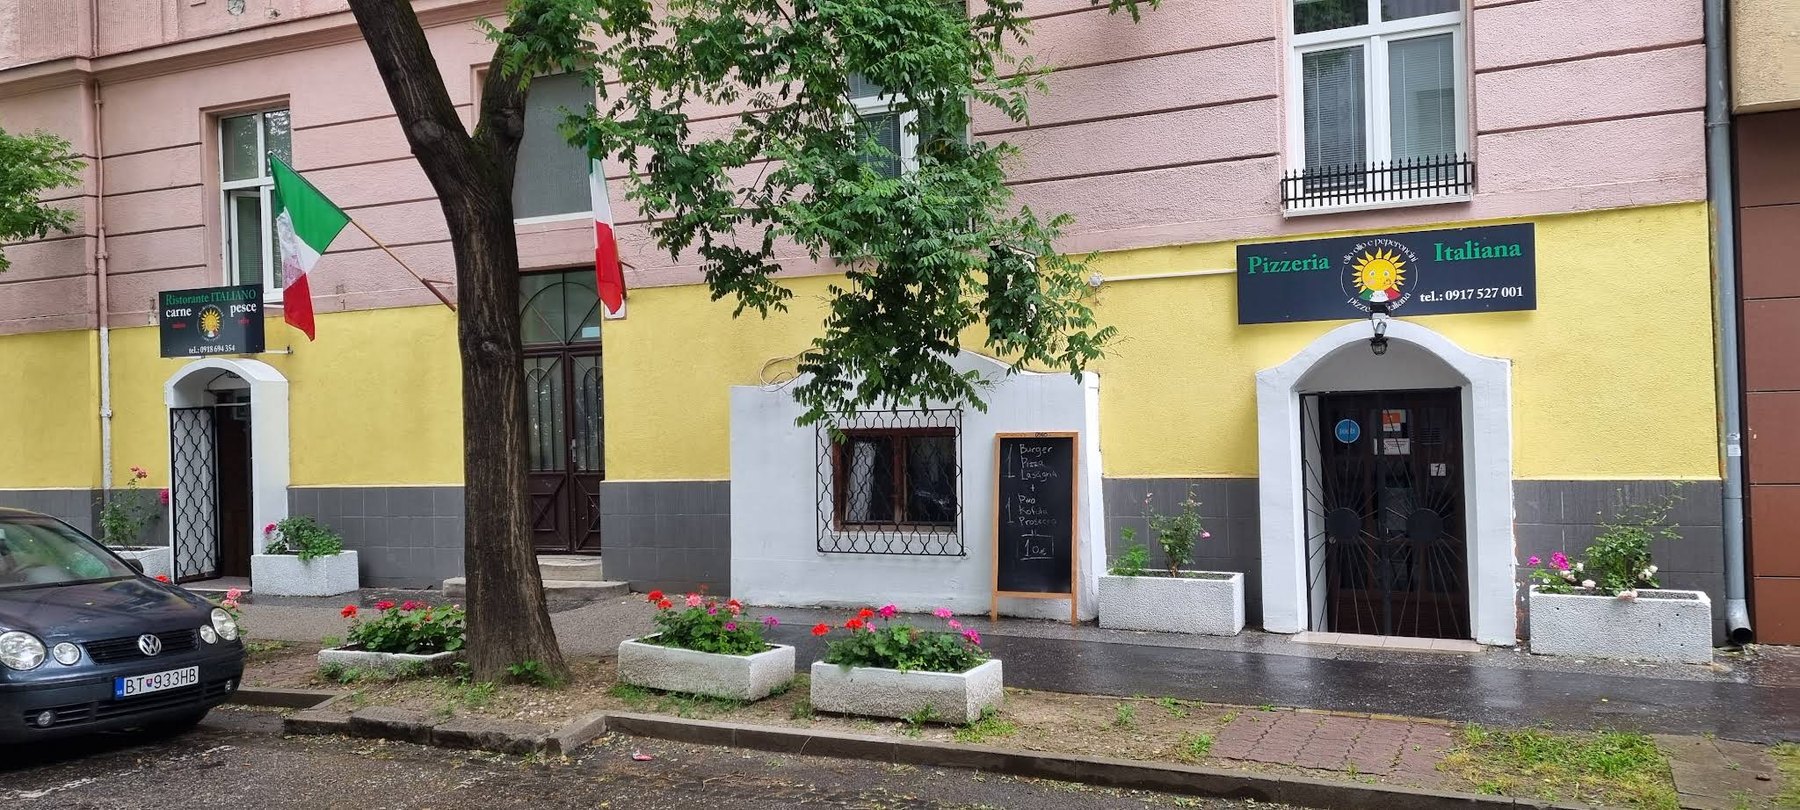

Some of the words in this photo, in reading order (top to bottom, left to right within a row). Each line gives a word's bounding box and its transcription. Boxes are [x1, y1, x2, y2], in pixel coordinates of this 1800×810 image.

[1247, 253, 1331, 274] Pizzeria
[1434, 240, 1522, 262] Italiana
[165, 293, 209, 306] Ristorante
[211, 289, 256, 301] ITALIANO
[1420, 290, 1443, 302] tel.:
[1445, 289, 1474, 301] 0917
[1476, 287, 1499, 299] 527
[1501, 286, 1523, 298] 001
[165, 308, 192, 317] carne
[230, 303, 257, 317] pesce
[225, 344, 236, 352] 354
[1020, 443, 1053, 457] Burger
[1021, 456, 1044, 469] Pizza
[126, 677, 144, 694] BT
[154, 668, 197, 689] 933HB
